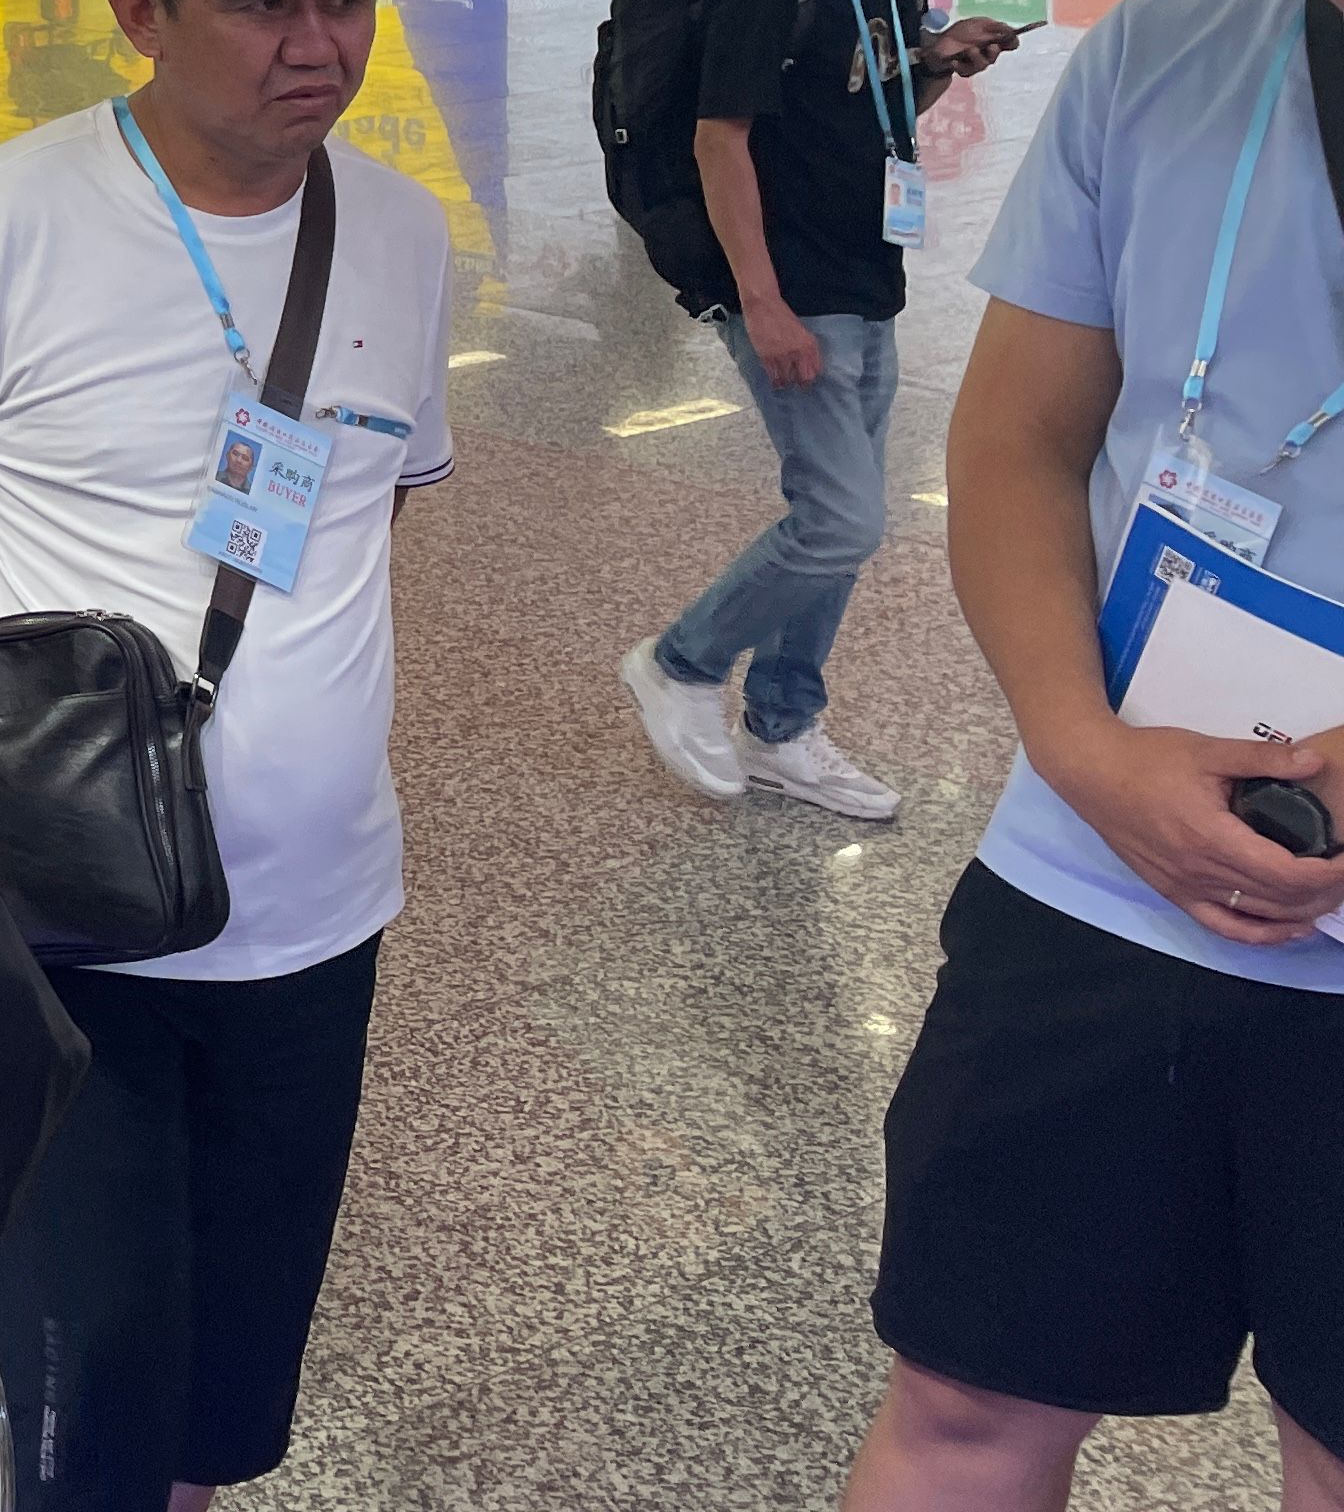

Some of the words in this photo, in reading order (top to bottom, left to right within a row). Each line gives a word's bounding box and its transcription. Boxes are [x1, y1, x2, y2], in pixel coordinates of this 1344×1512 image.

[269, 461, 316, 493] 采购商
[268, 478, 306, 508] BUYER
